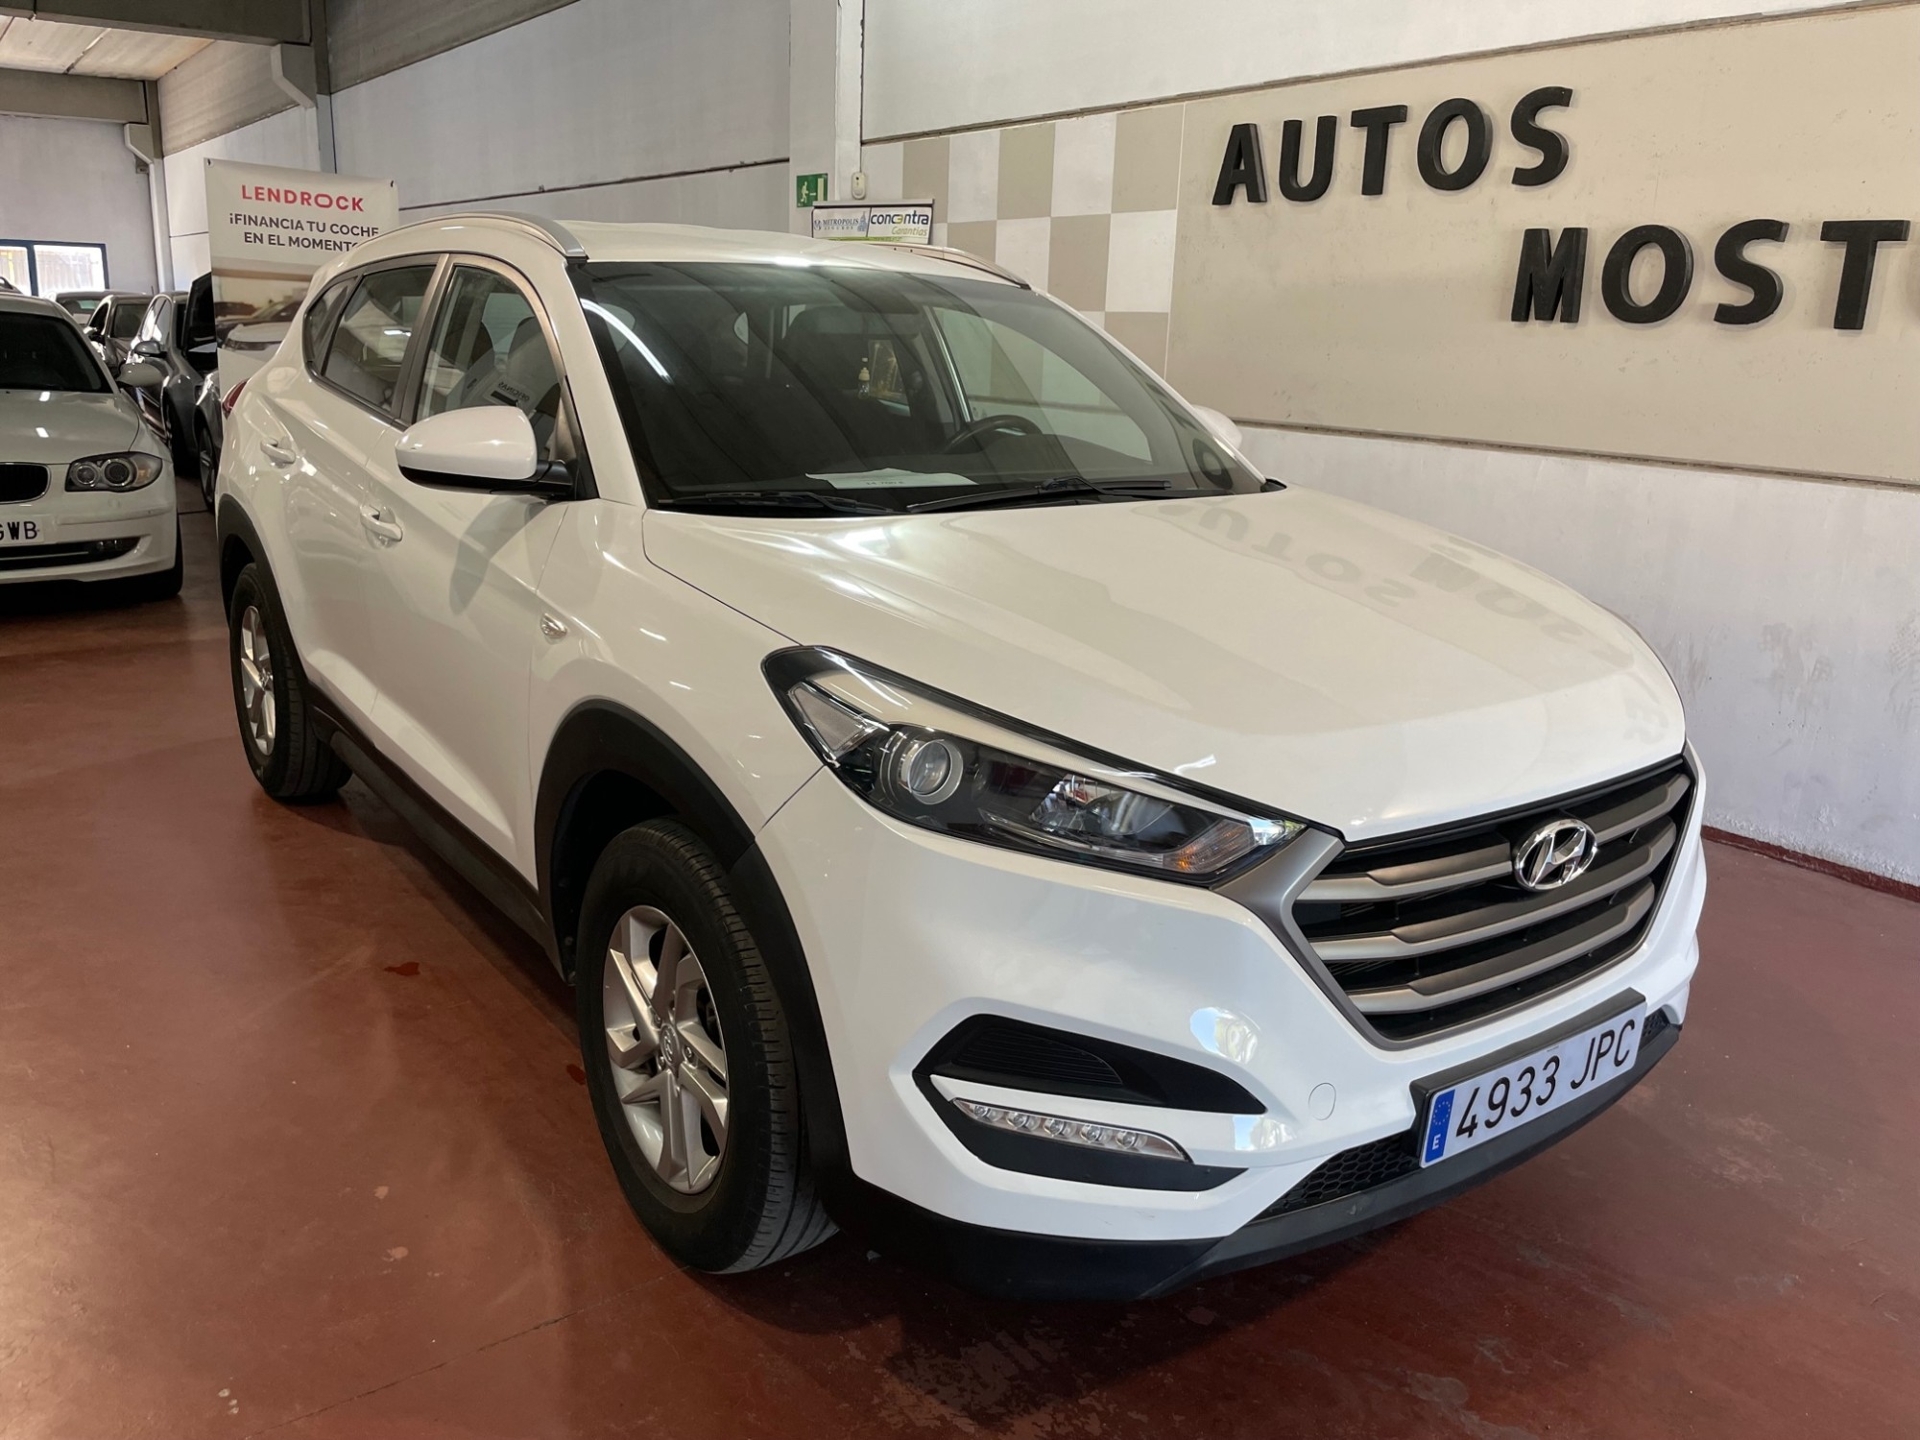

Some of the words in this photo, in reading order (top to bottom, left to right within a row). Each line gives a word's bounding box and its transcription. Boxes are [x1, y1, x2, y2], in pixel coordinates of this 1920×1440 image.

[1212, 85, 1574, 205] AUTOS
[241, 185, 364, 212] LENDROCK
[307, 221, 326, 233] TU
[870, 210, 929, 226] concentra
[244, 232, 264, 245] EN
[268, 234, 286, 247] EL
[288, 236, 358, 252] MOMENT
[1510, 219, 1911, 331] MOST
[1455, 1055, 1560, 1139] 4933
[1570, 1019, 1636, 1090] JPC
[1432, 1134, 1441, 1150] E
